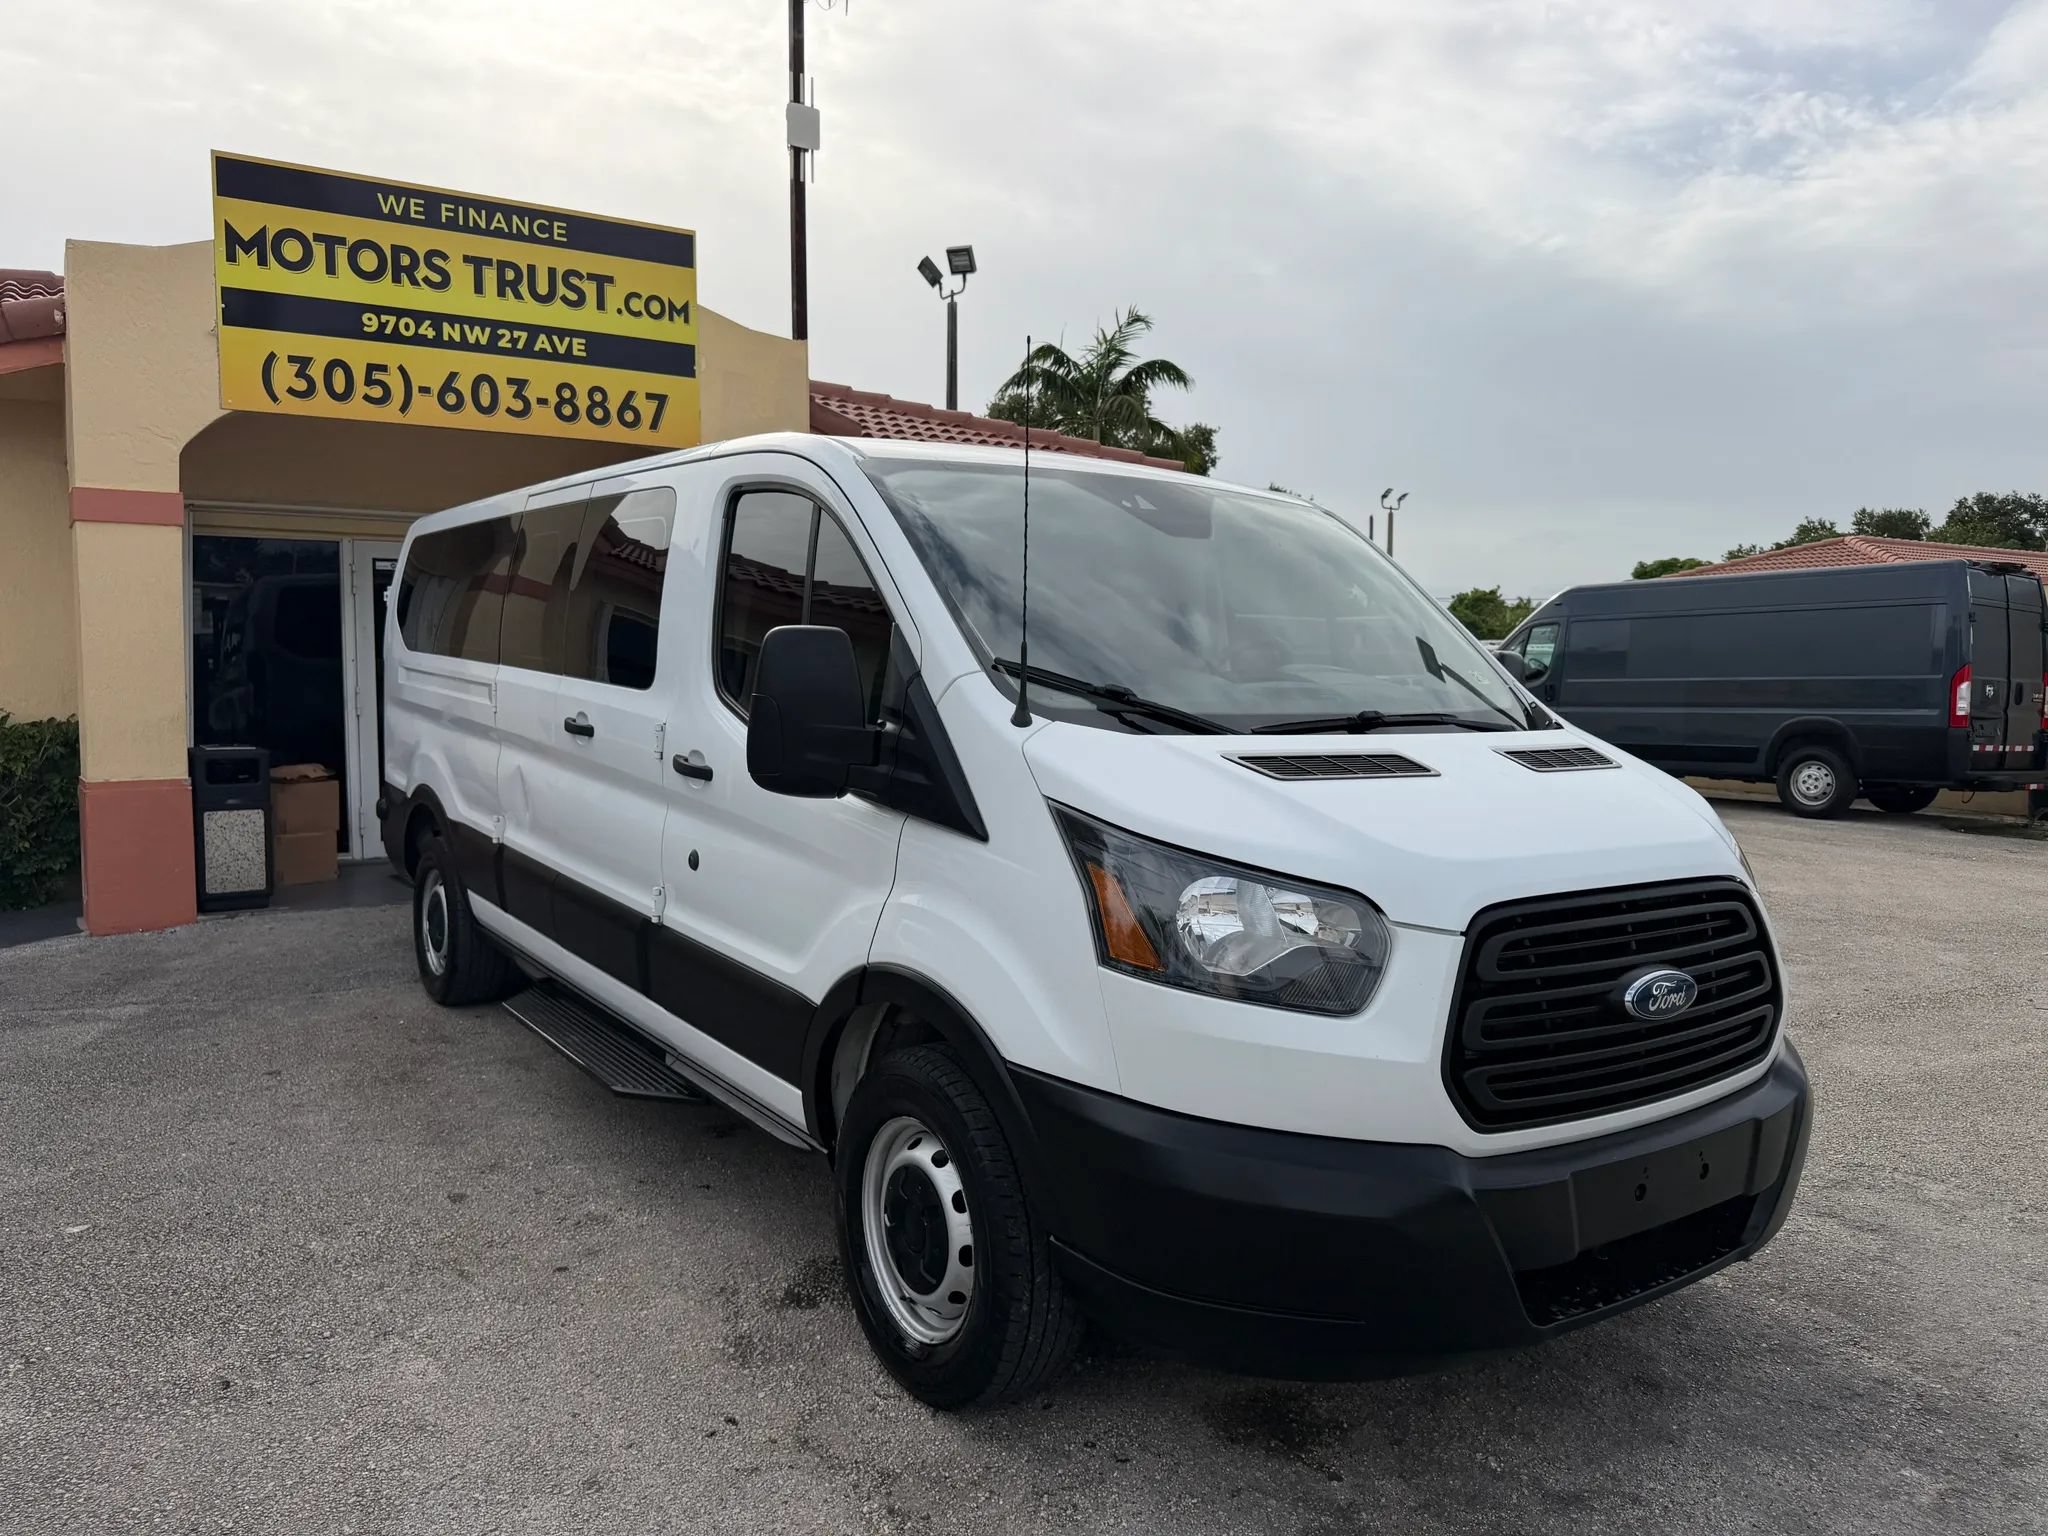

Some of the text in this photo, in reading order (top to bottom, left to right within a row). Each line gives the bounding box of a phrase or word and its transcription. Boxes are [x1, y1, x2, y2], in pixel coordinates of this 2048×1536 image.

[377, 193, 568, 242] WE FINANCE
[224, 218, 451, 291] MOTORS
[361, 312, 587, 357] 9704 NW 27 AVE
[261, 350, 670, 433] (305)-603-8867
[1648, 980, 1687, 1012] Ford
